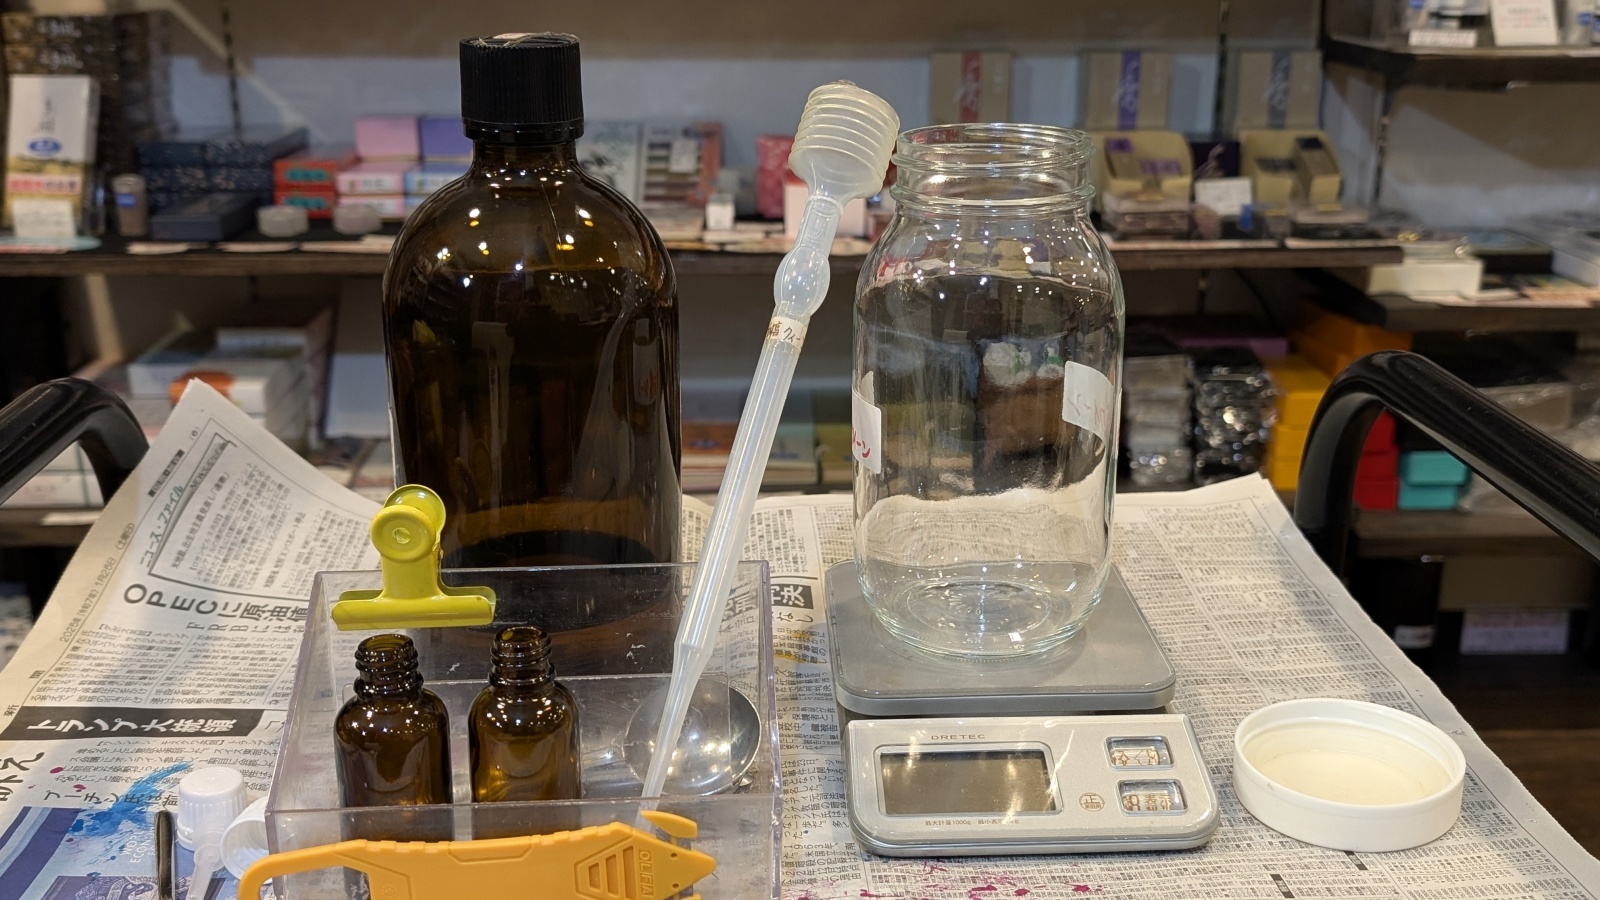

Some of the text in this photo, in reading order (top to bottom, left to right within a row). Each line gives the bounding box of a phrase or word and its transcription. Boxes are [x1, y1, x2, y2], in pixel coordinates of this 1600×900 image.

[26, 716, 238, 734] トランプ大統領
[782, 858, 860, 869] 領暗殺の記録は
[639, 849, 655, 898] OLFA
